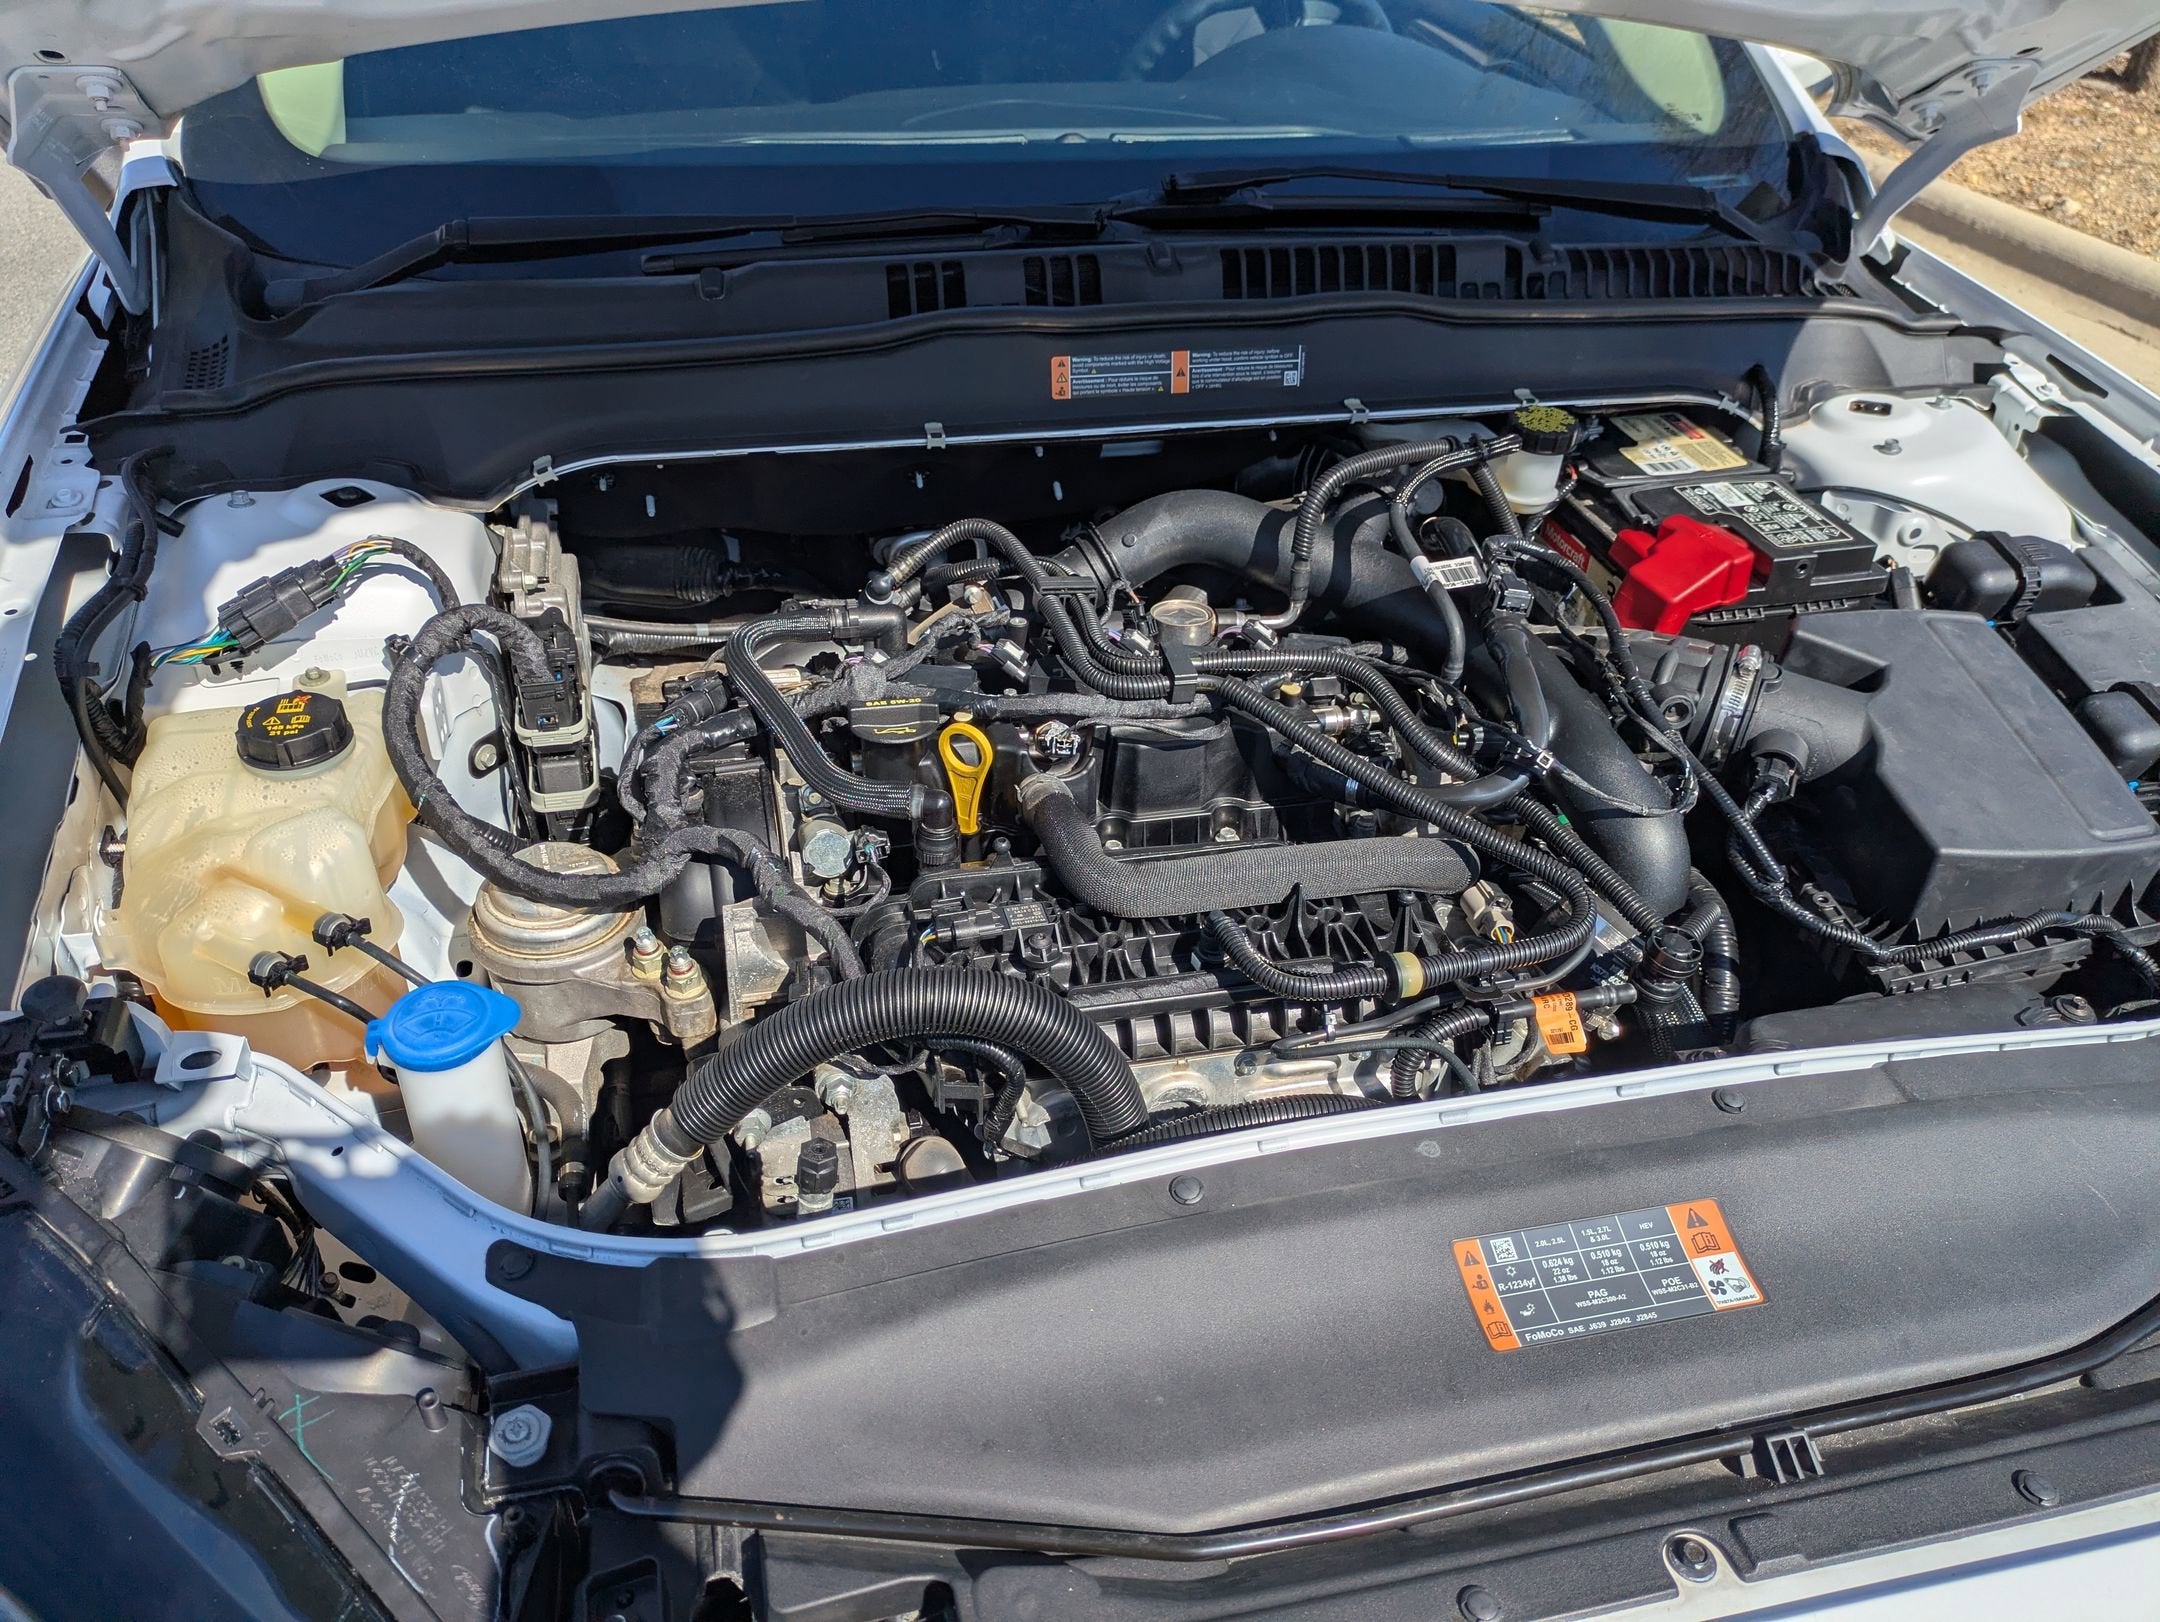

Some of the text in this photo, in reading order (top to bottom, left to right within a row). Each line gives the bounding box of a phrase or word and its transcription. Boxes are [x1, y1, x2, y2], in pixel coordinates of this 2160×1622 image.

[1638, 1221, 1654, 1230] HEV
[1639, 1239, 1671, 1252] 0.510 kg
[1590, 1247, 1623, 1260] 0.510 kg
[1649, 1250, 1658, 1258] 18
[1541, 1256, 1575, 1269] 0.624 kg
[1600, 1259, 1610, 1267] 18
[1649, 1258, 1663, 1266] 1.12
[1552, 1267, 1561, 1276] 22
[1600, 1265, 1626, 1276] 1.12 lbs
[1566, 1274, 1578, 1282] lbs
[1661, 1275, 1683, 1287] POE
[1497, 1276, 1537, 1292] R-1234yf
[1587, 1287, 1608, 1299] PAG
[1525, 1311, 1658, 1342] FoMoCo SAE J639 J2842 J2845
